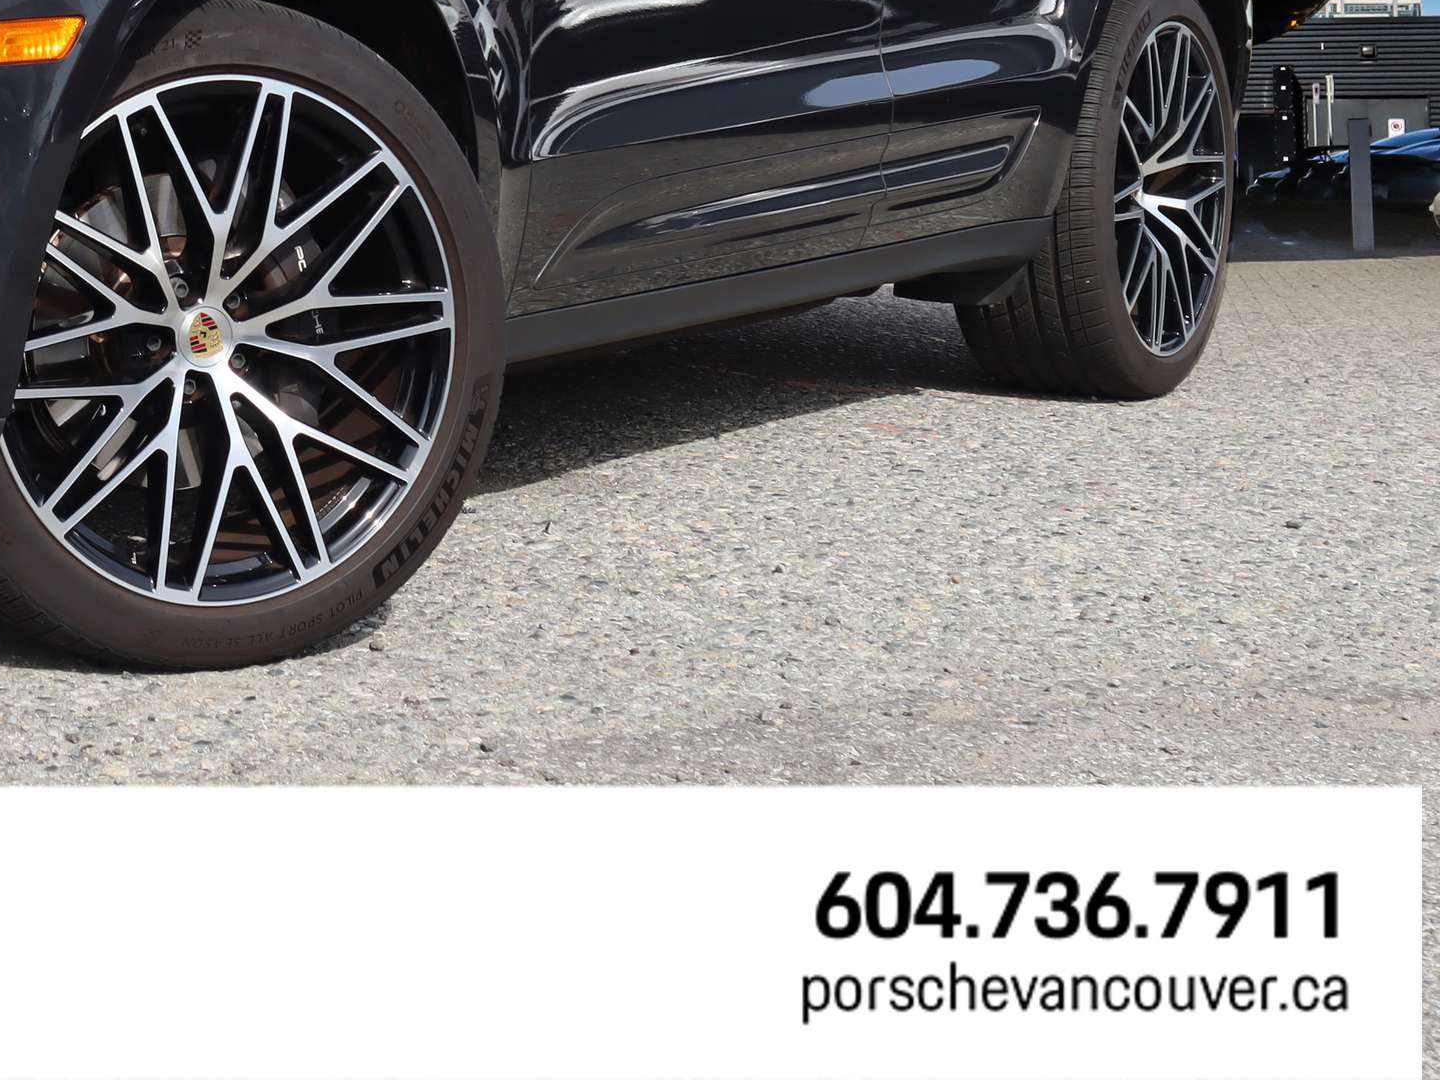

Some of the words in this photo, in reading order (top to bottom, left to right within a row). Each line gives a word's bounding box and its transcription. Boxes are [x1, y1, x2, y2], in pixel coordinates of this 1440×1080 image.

[377, 417, 482, 584] MICHELIN
[329, 589, 363, 617] PILOT
[279, 614, 323, 639] SPORT
